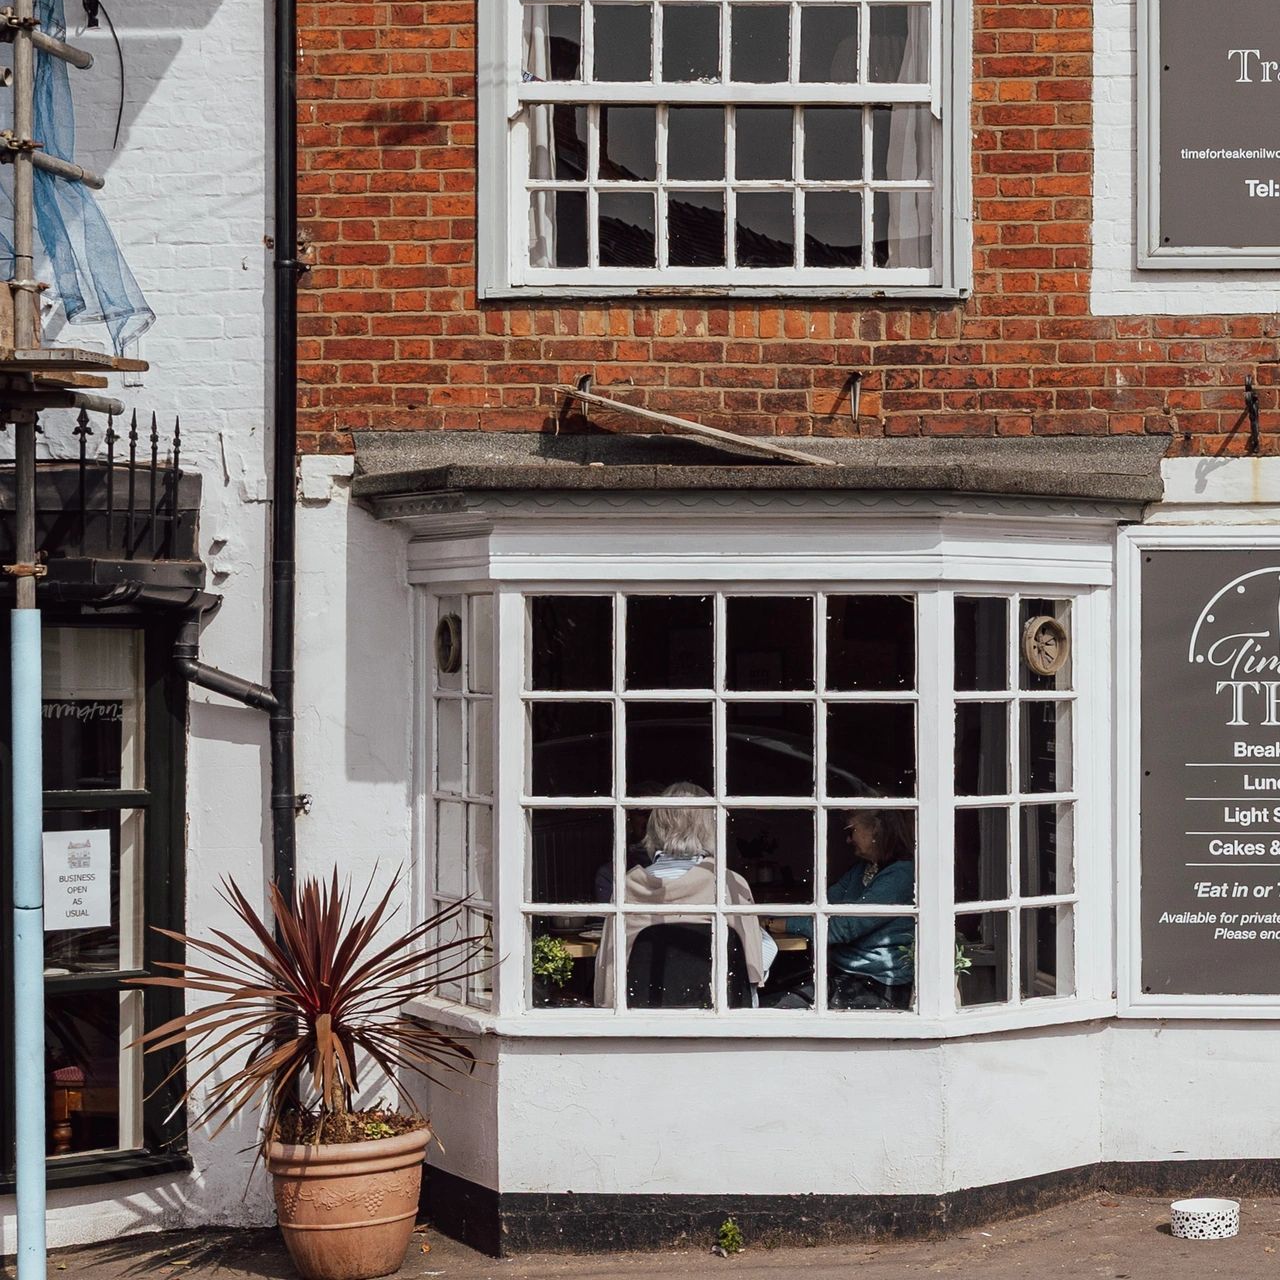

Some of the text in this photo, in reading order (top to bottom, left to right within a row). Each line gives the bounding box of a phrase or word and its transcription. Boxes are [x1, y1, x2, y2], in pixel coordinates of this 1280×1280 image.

[1244, 179, 1280, 197] Tel:
[1224, 806, 1270, 827] Light
[1208, 839, 1266, 856] Cakes
[59, 873, 96, 883] BUSINESS
[66, 885, 88, 894] OPEN
[1231, 882, 1249, 898] in
[1253, 885, 1274, 898] or
[72, 897, 83, 905] AS
[65, 909, 90, 918] USUAL
[1158, 911, 1217, 924] Available
[1219, 911, 1239, 924] for
[1214, 927, 1257, 940] Please
